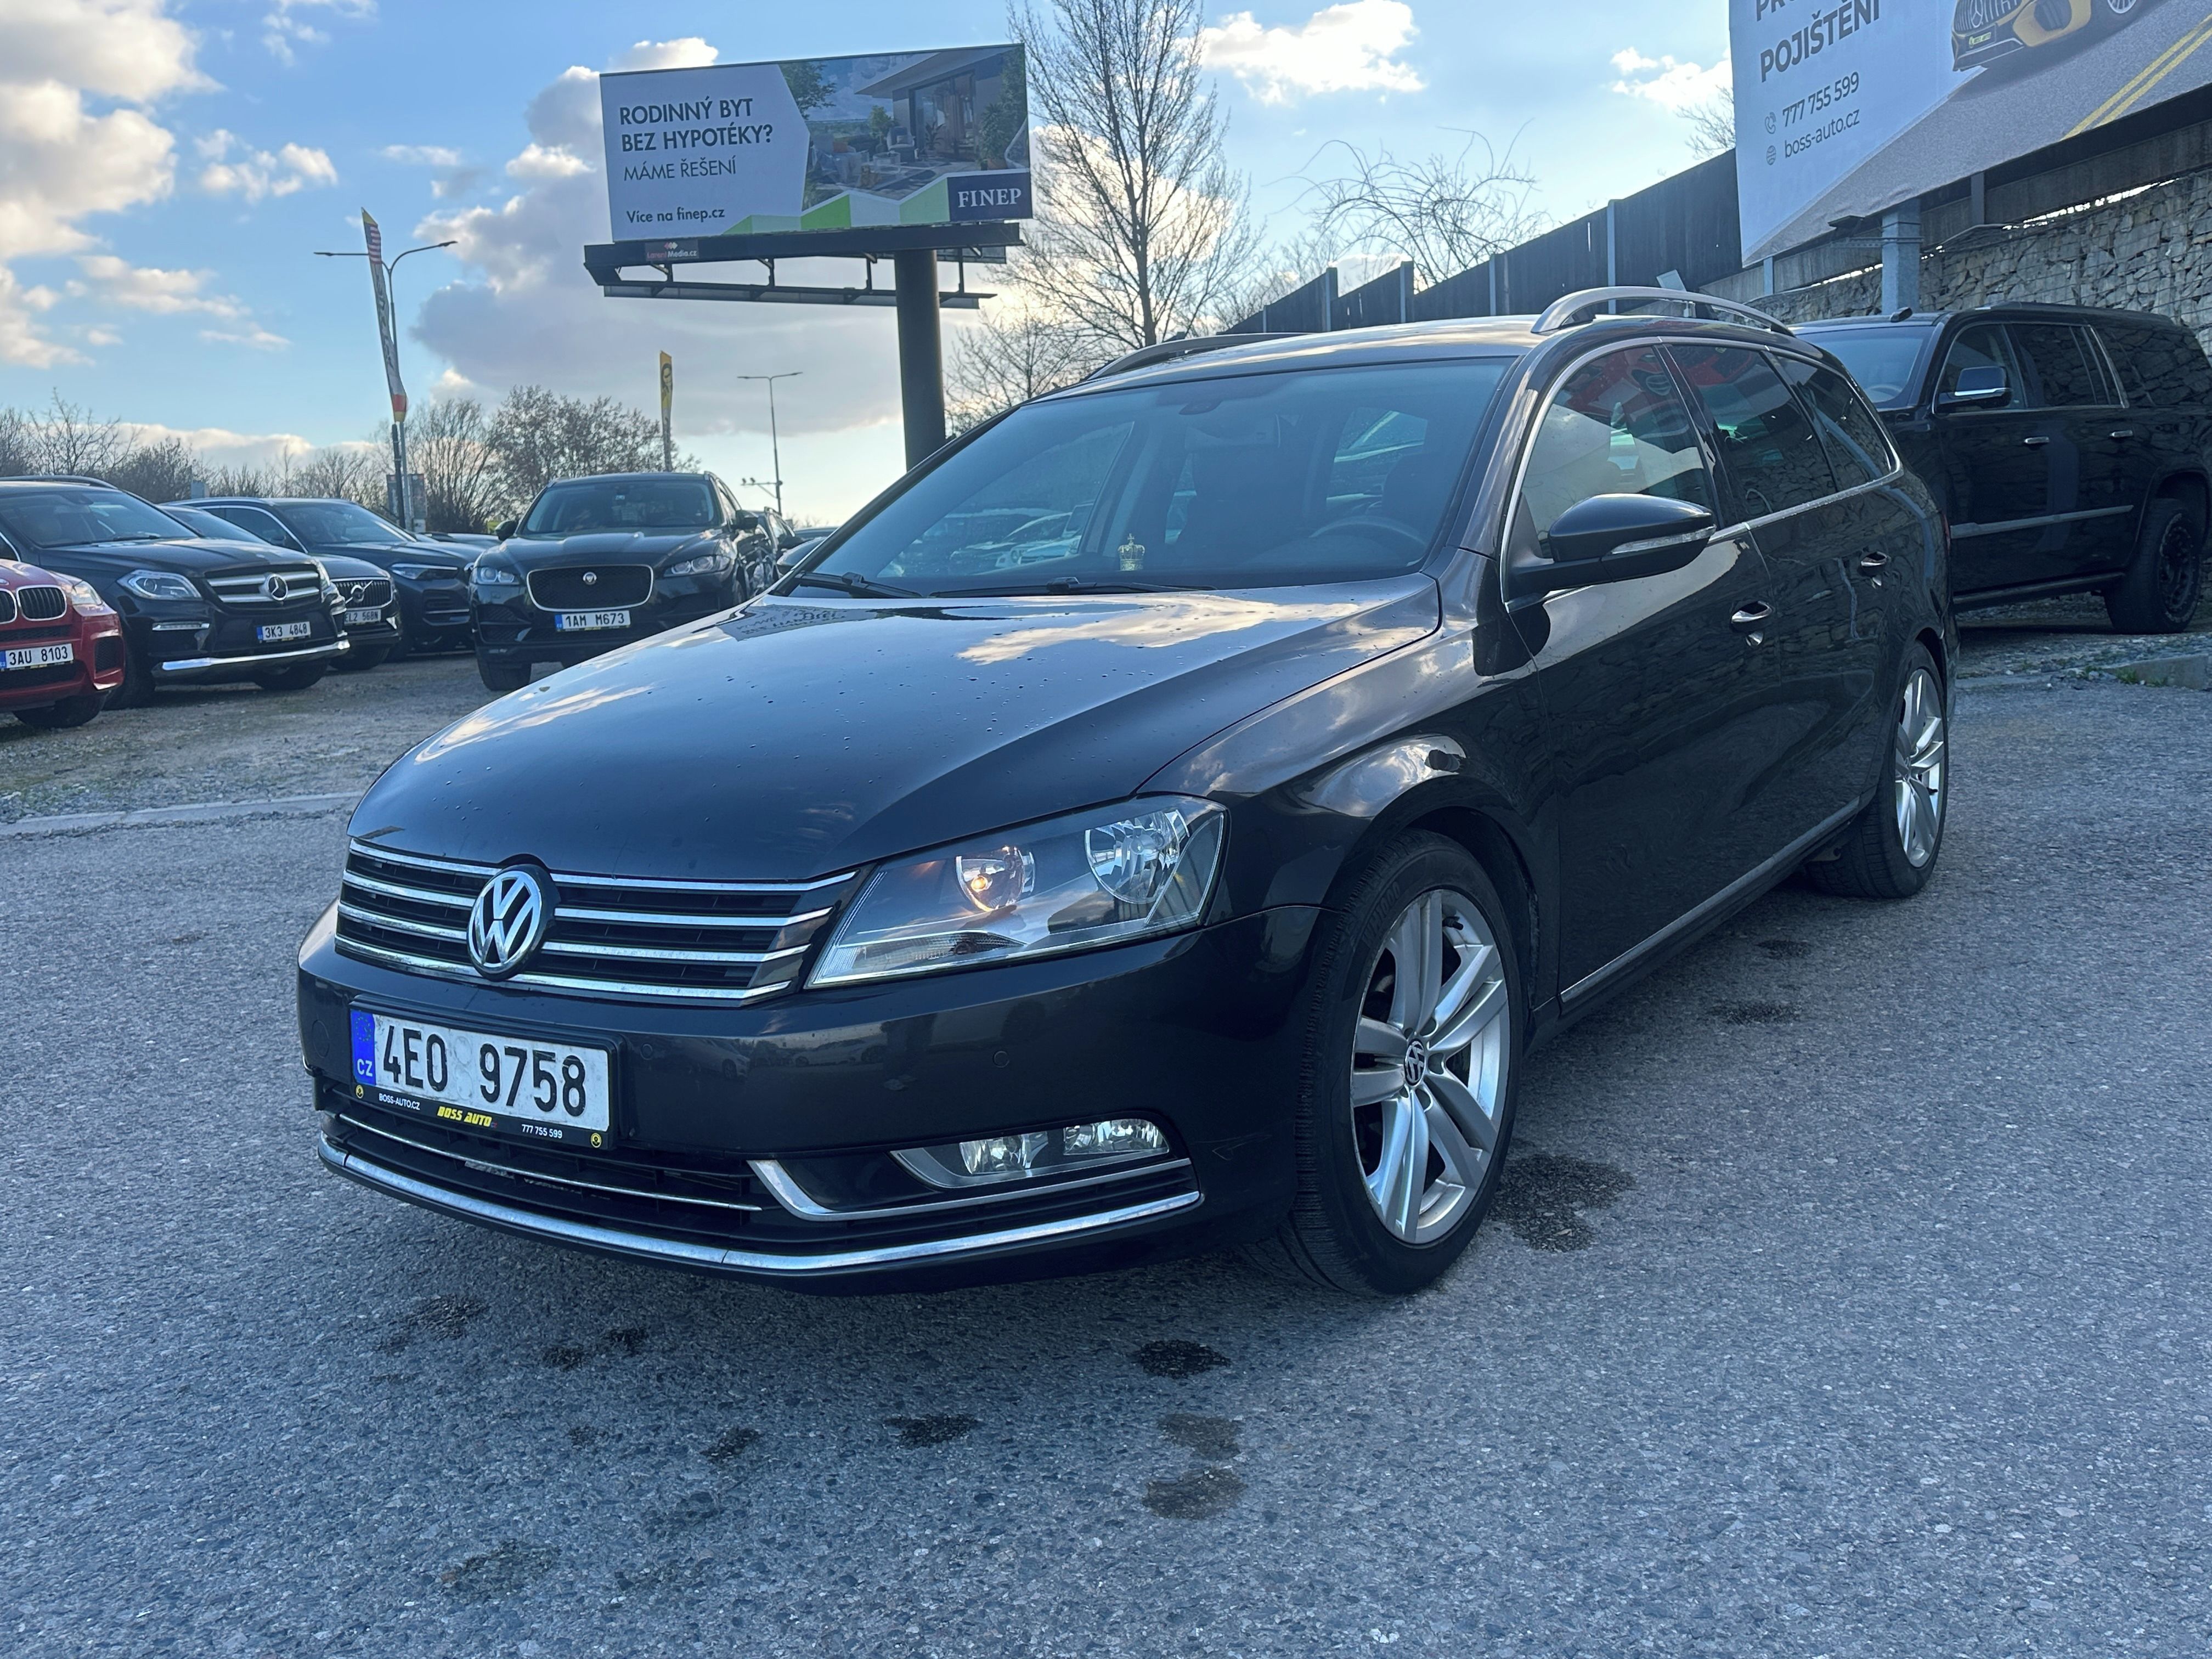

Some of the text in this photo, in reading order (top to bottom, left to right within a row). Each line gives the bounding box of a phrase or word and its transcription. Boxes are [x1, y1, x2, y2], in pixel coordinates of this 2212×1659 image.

[1782, 71, 1859, 127] 777 755 599
[619, 95, 753, 125] RODINNÝ BYT
[622, 121, 772, 152] BEZ HYPOTÉKY?
[1785, 109, 1860, 159] boss-auto.cz
[624, 155, 736, 181] MÁME ŘEŠENÍ
[958, 188, 1022, 208] FINEP
[627, 206, 725, 223] Více na finep.cz
[566, 612, 625, 627] 1AM M673
[265, 623, 308, 638] 3K3 4848
[9, 650, 32, 665] 3AU
[41, 646, 68, 662] 8103
[357, 1058, 374, 1077] CZ
[383, 1025, 586, 1118] 4E0 9758
[379, 1092, 421, 1111] BOSS-AUTO.CZ
[437, 1105, 493, 1128] BOSS AUTO
[522, 1123, 563, 1139] 777 755 599
